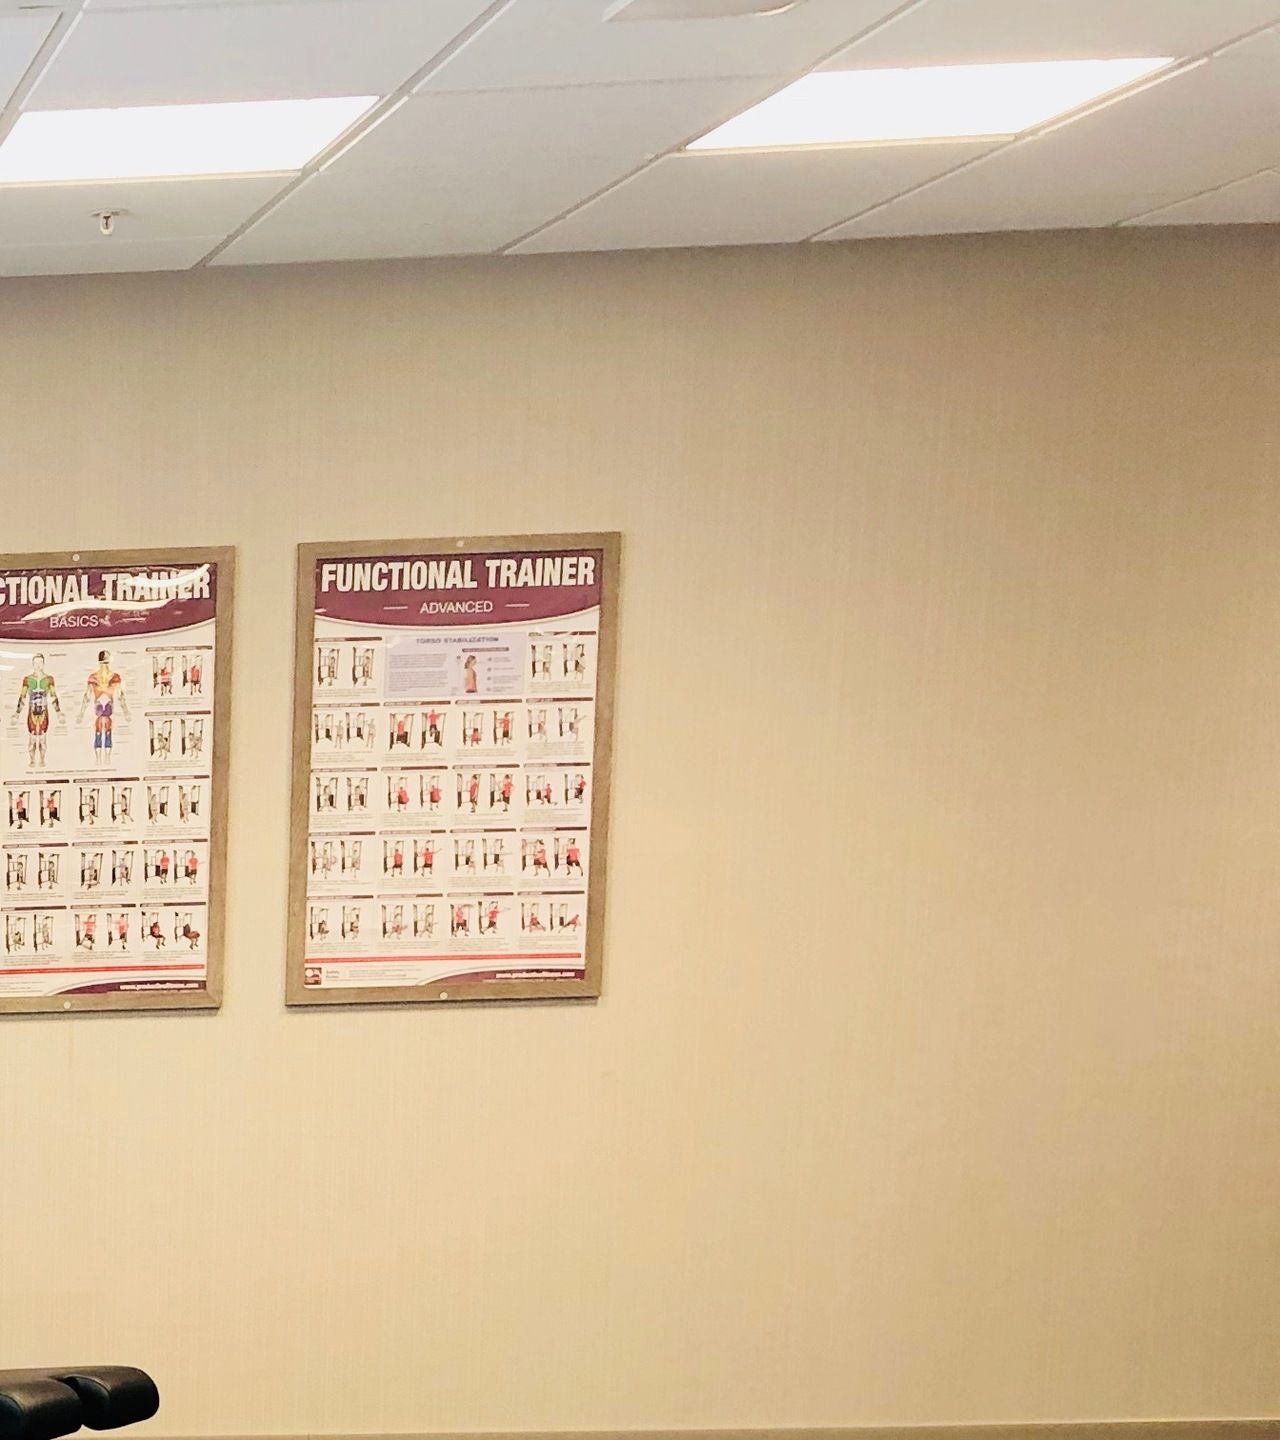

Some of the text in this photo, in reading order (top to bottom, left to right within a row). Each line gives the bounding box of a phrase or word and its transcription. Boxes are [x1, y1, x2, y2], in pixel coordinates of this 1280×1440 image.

[102, 567, 210, 601] TRAINER
[321, 556, 595, 592] FUNCTIONAL TRAINER
[419, 600, 493, 615] ADVANCED
[49, 615, 99, 629] BASICS
